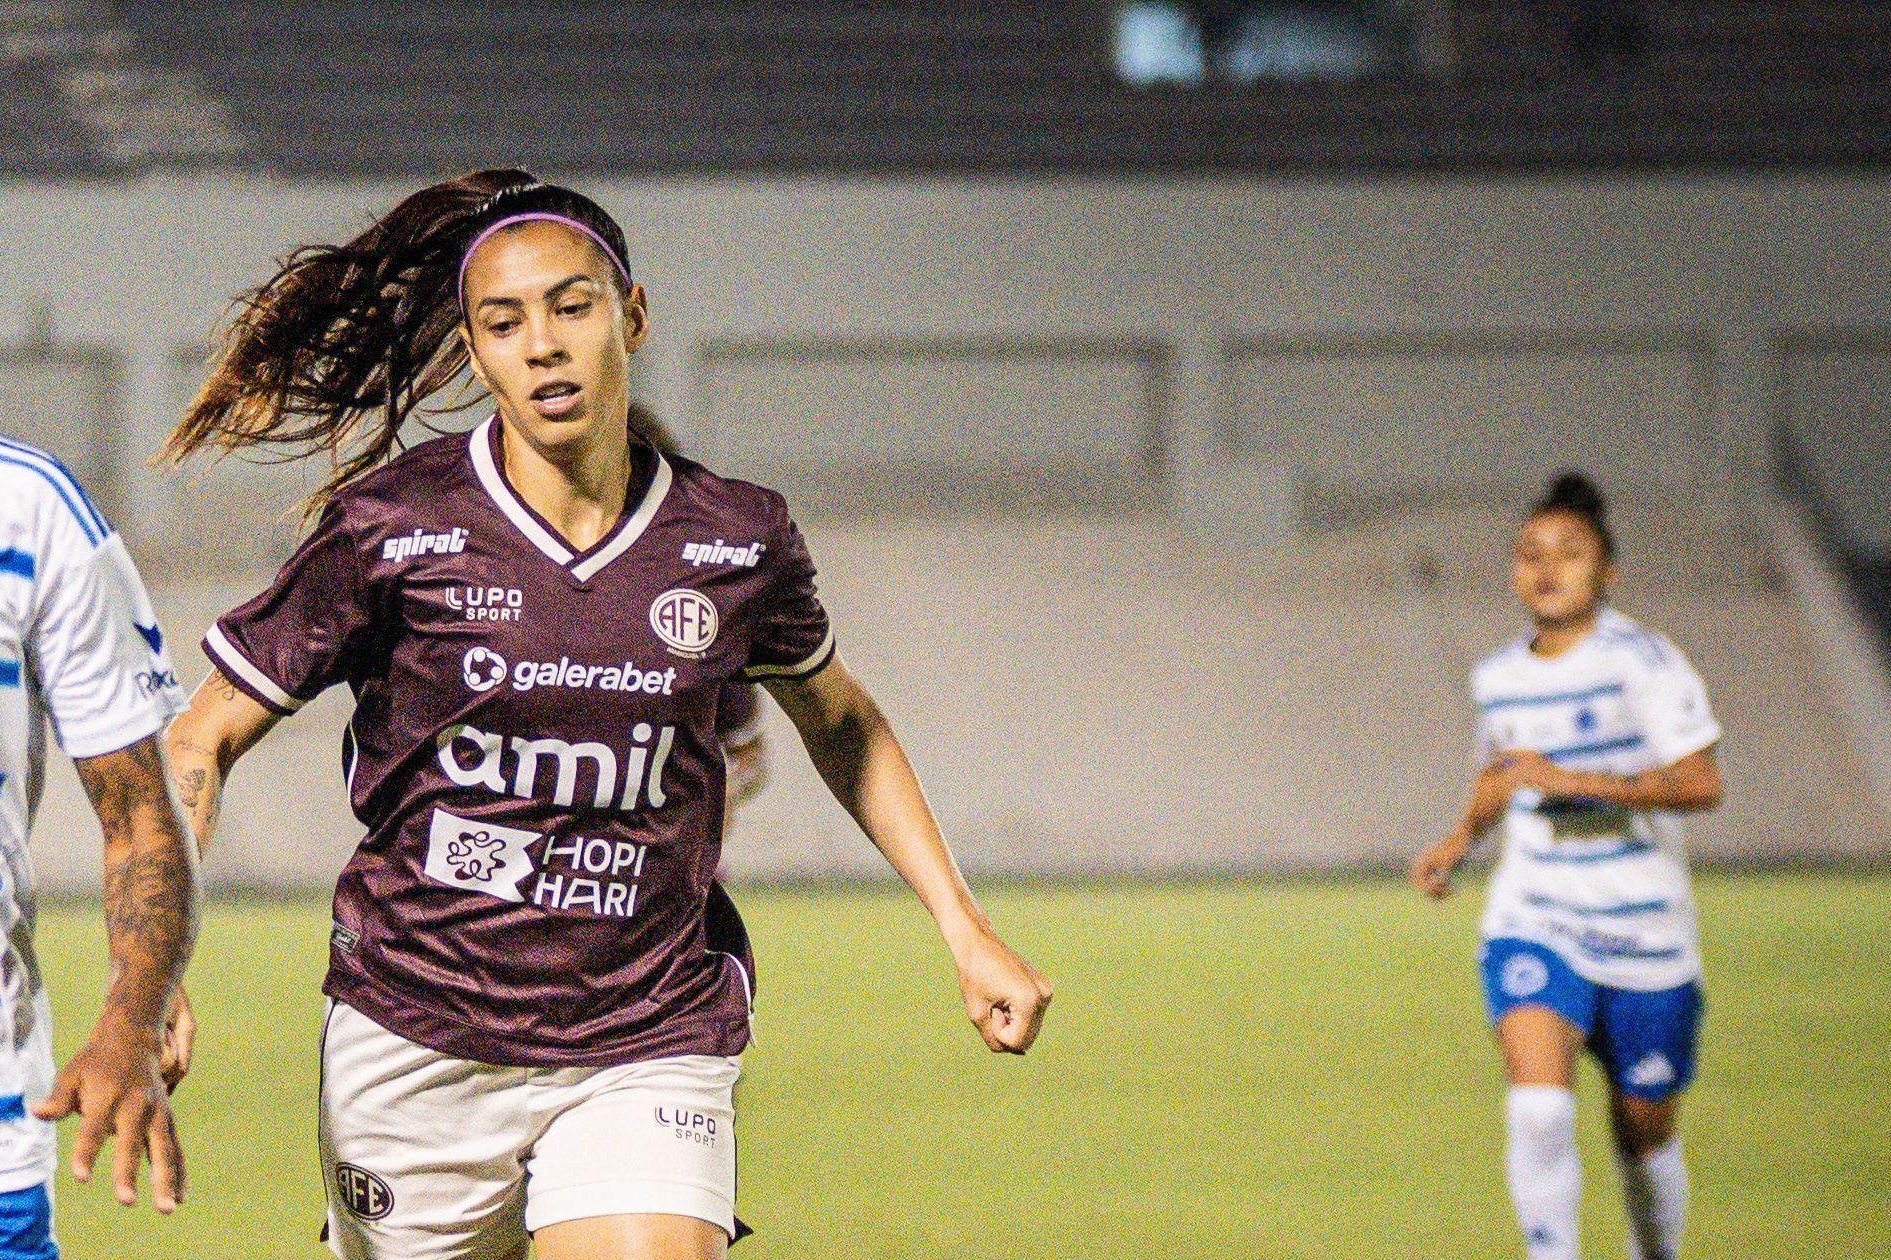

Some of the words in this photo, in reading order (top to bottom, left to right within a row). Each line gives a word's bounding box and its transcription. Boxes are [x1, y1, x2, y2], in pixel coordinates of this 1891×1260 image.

[383, 527, 465, 563] spiral
[682, 538, 760, 568] spiral
[445, 587, 523, 610] LUPO
[466, 608, 522, 621] SPORT
[513, 656, 676, 695] galerabet
[437, 722, 675, 811] amil
[542, 835, 647, 877] HOPI
[534, 872, 638, 917] HARI
[655, 1107, 716, 1135] LUPO
[675, 1128, 716, 1149] SPORT
